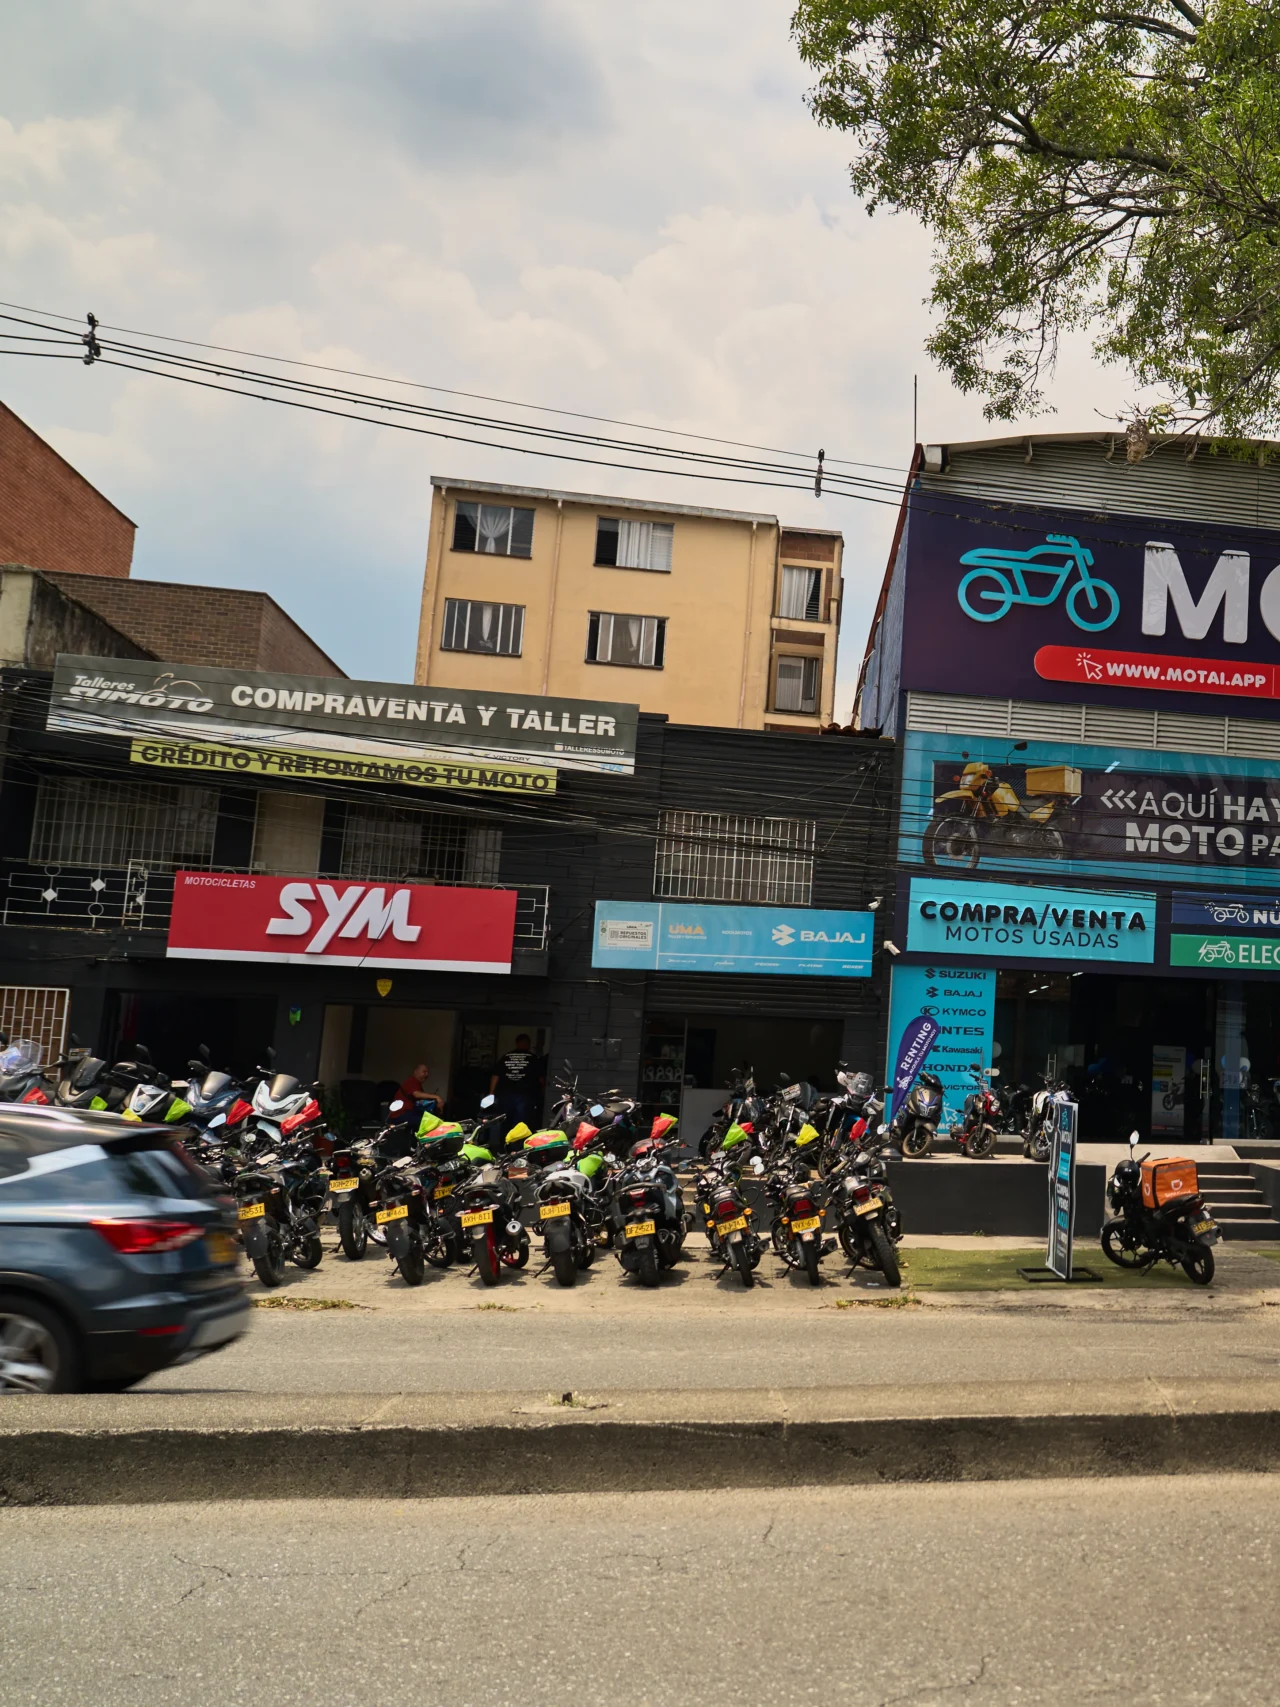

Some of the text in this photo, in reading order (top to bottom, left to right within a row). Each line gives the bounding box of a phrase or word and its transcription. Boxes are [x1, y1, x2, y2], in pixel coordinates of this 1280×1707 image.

[75, 675, 135, 691] Talleres
[1106, 662, 1266, 688] WWW.MOTAI.APP
[62, 686, 214, 712] SUMOTO
[231, 685, 616, 736] COMPRAVENTA Y TALLER
[141, 744, 549, 791] CRÉDITO Y RETOMAMOS TU MOTO
[1138, 787, 1219, 819] AQUÍ
[1125, 822, 1245, 857] MOTO
[184, 876, 256, 889] MOTOCICLETAS
[265, 882, 422, 953] SYM
[920, 900, 1146, 931] COMPRA/VENTA
[669, 923, 704, 935] UMA
[800, 930, 866, 944] BAJAJ
[945, 925, 1119, 949] MOTOS USADAS
[938, 970, 986, 980] SUZUKI
[943, 989, 982, 997] BAJAJ
[942, 1008, 986, 1017] KYMCO
[900, 1022, 931, 1070] RENTING
[942, 1045, 982, 1054] Kawasaki
